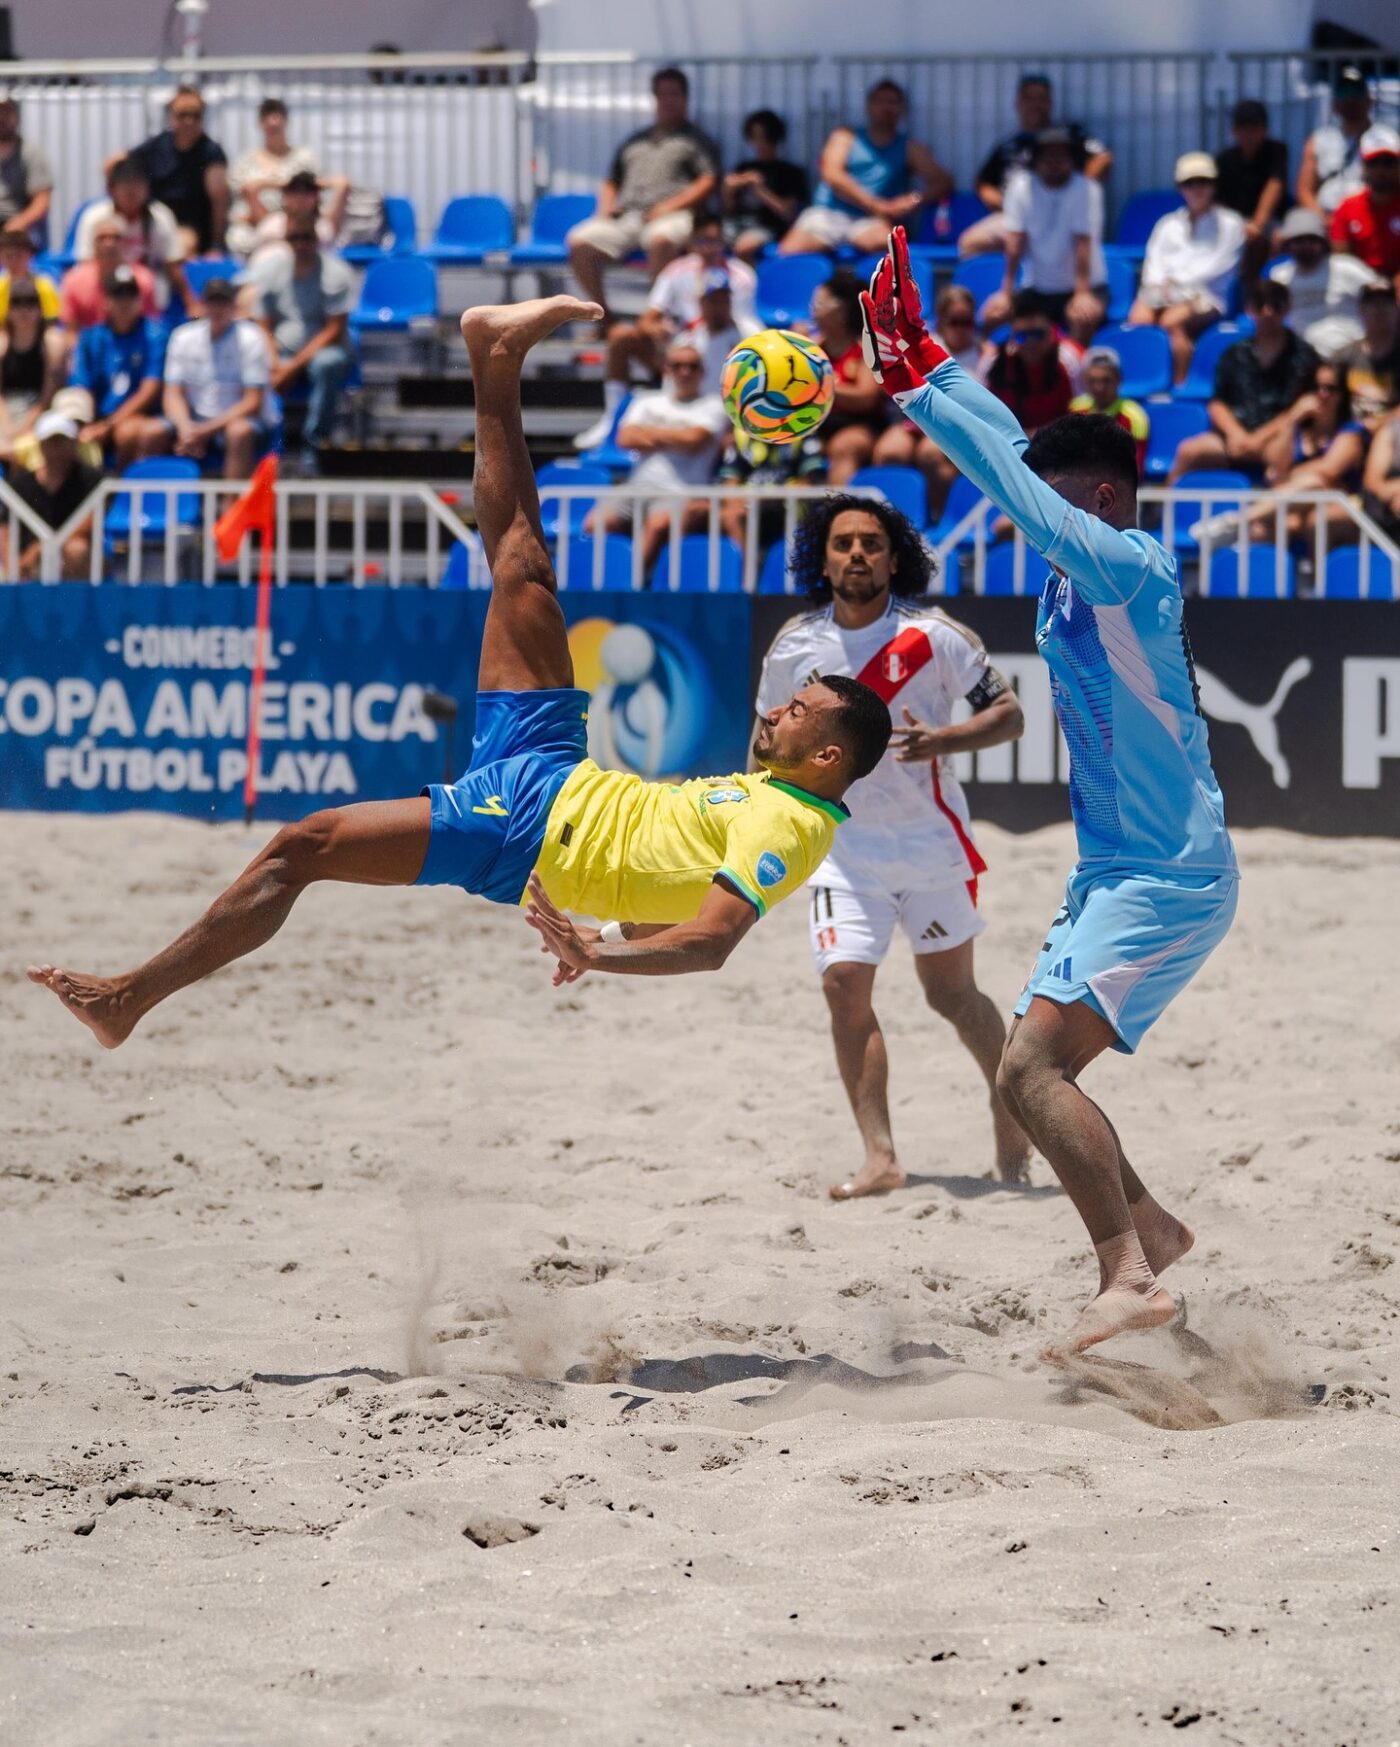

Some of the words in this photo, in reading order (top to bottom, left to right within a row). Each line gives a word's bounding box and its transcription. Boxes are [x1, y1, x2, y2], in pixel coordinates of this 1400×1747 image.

[0, 676, 136, 737] OPA
[45, 735, 214, 793] FÚTBOL
[218, 749, 357, 794] PLAYA
